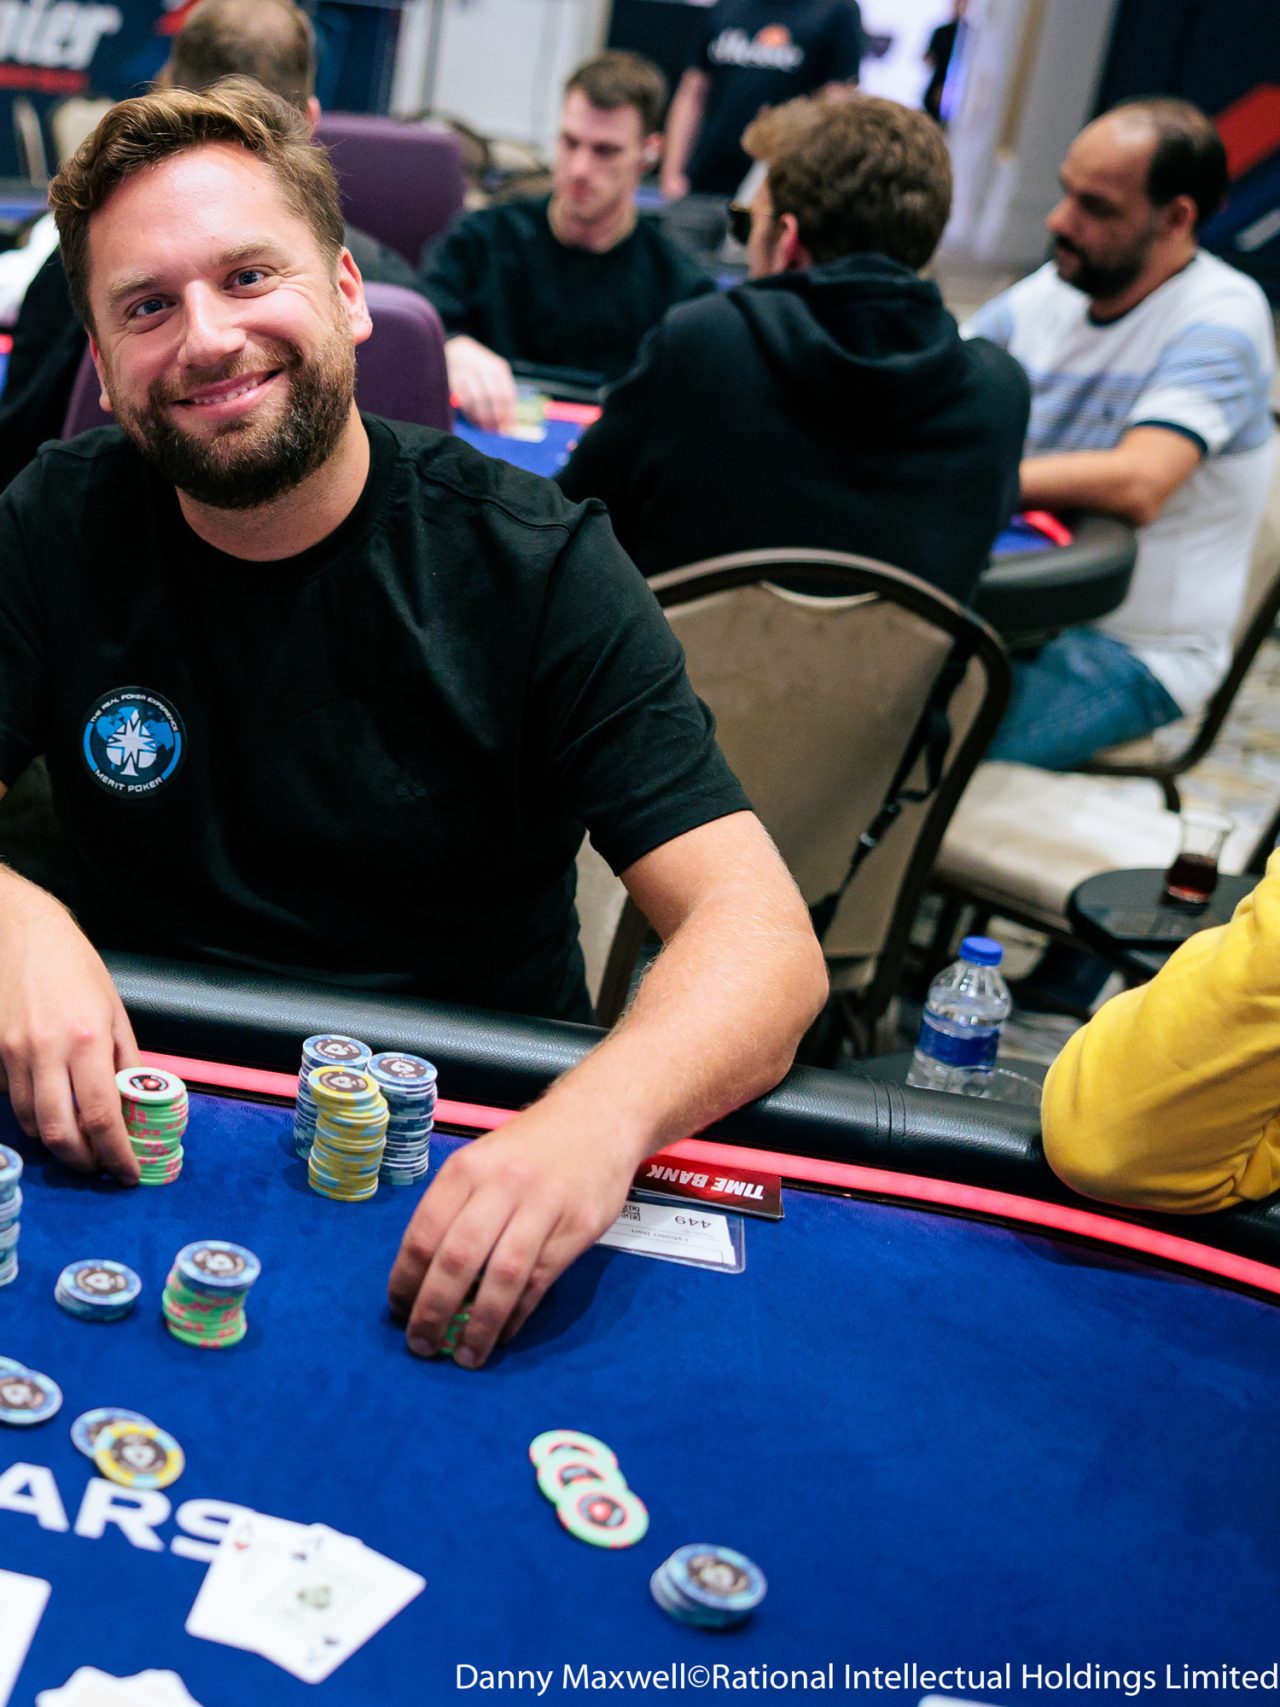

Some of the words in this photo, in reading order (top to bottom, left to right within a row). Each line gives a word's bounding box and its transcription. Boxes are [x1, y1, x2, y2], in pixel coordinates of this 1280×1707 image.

[94, 769, 126, 791] MERIT
[128, 776, 163, 792] POKER
[647, 1164, 709, 1187] BANK
[712, 1177, 764, 1200] TIME
[674, 1215, 712, 1229] 449
